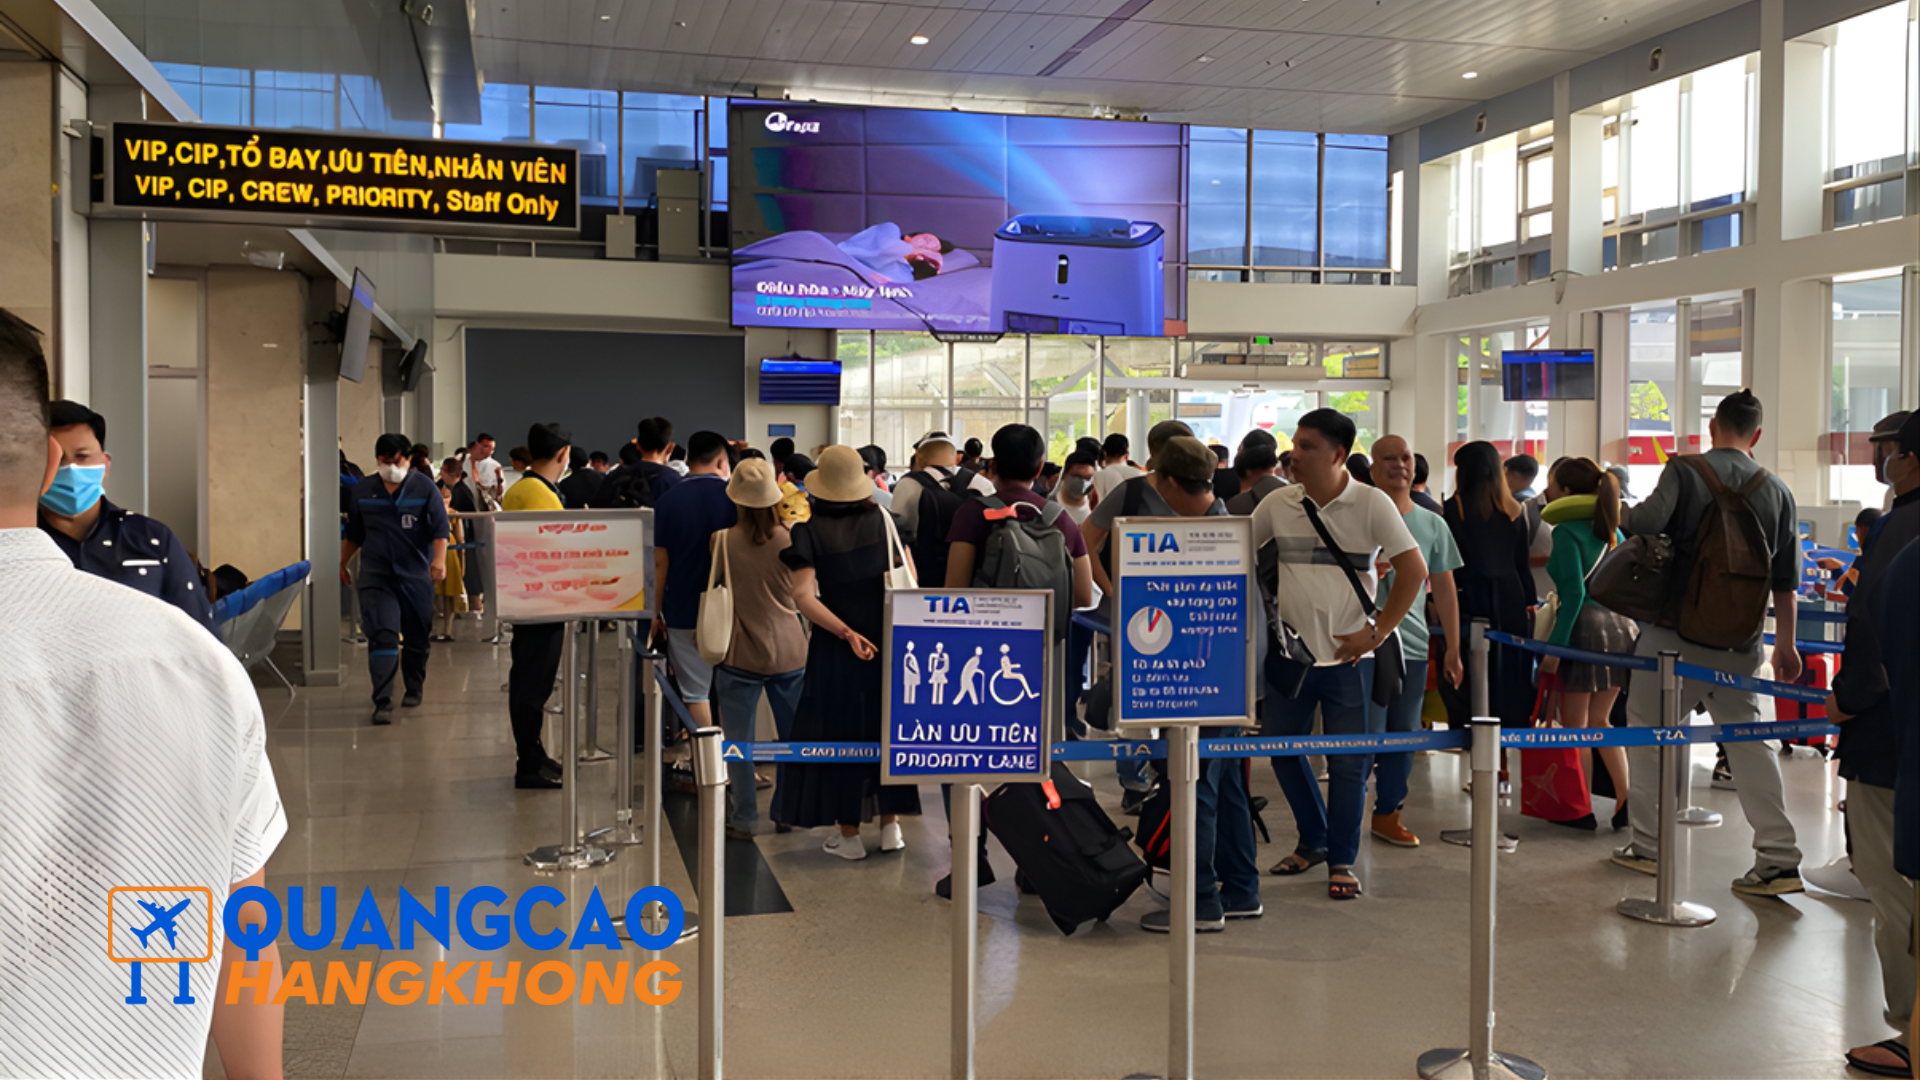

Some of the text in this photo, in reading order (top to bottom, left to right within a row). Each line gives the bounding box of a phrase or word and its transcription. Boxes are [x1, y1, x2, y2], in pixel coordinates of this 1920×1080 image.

[268, 146, 363, 175] BAY,ƯU
[510, 156, 567, 184] VIÊN
[135, 174, 559, 222] VIP, CIP, CREW, PRIORITY, Staff Only
[1125, 532, 1180, 554] TIA
[923, 595, 970, 614] TIA
[897, 718, 942, 742] LÀN
[1108, 743, 1152, 757] TIA
